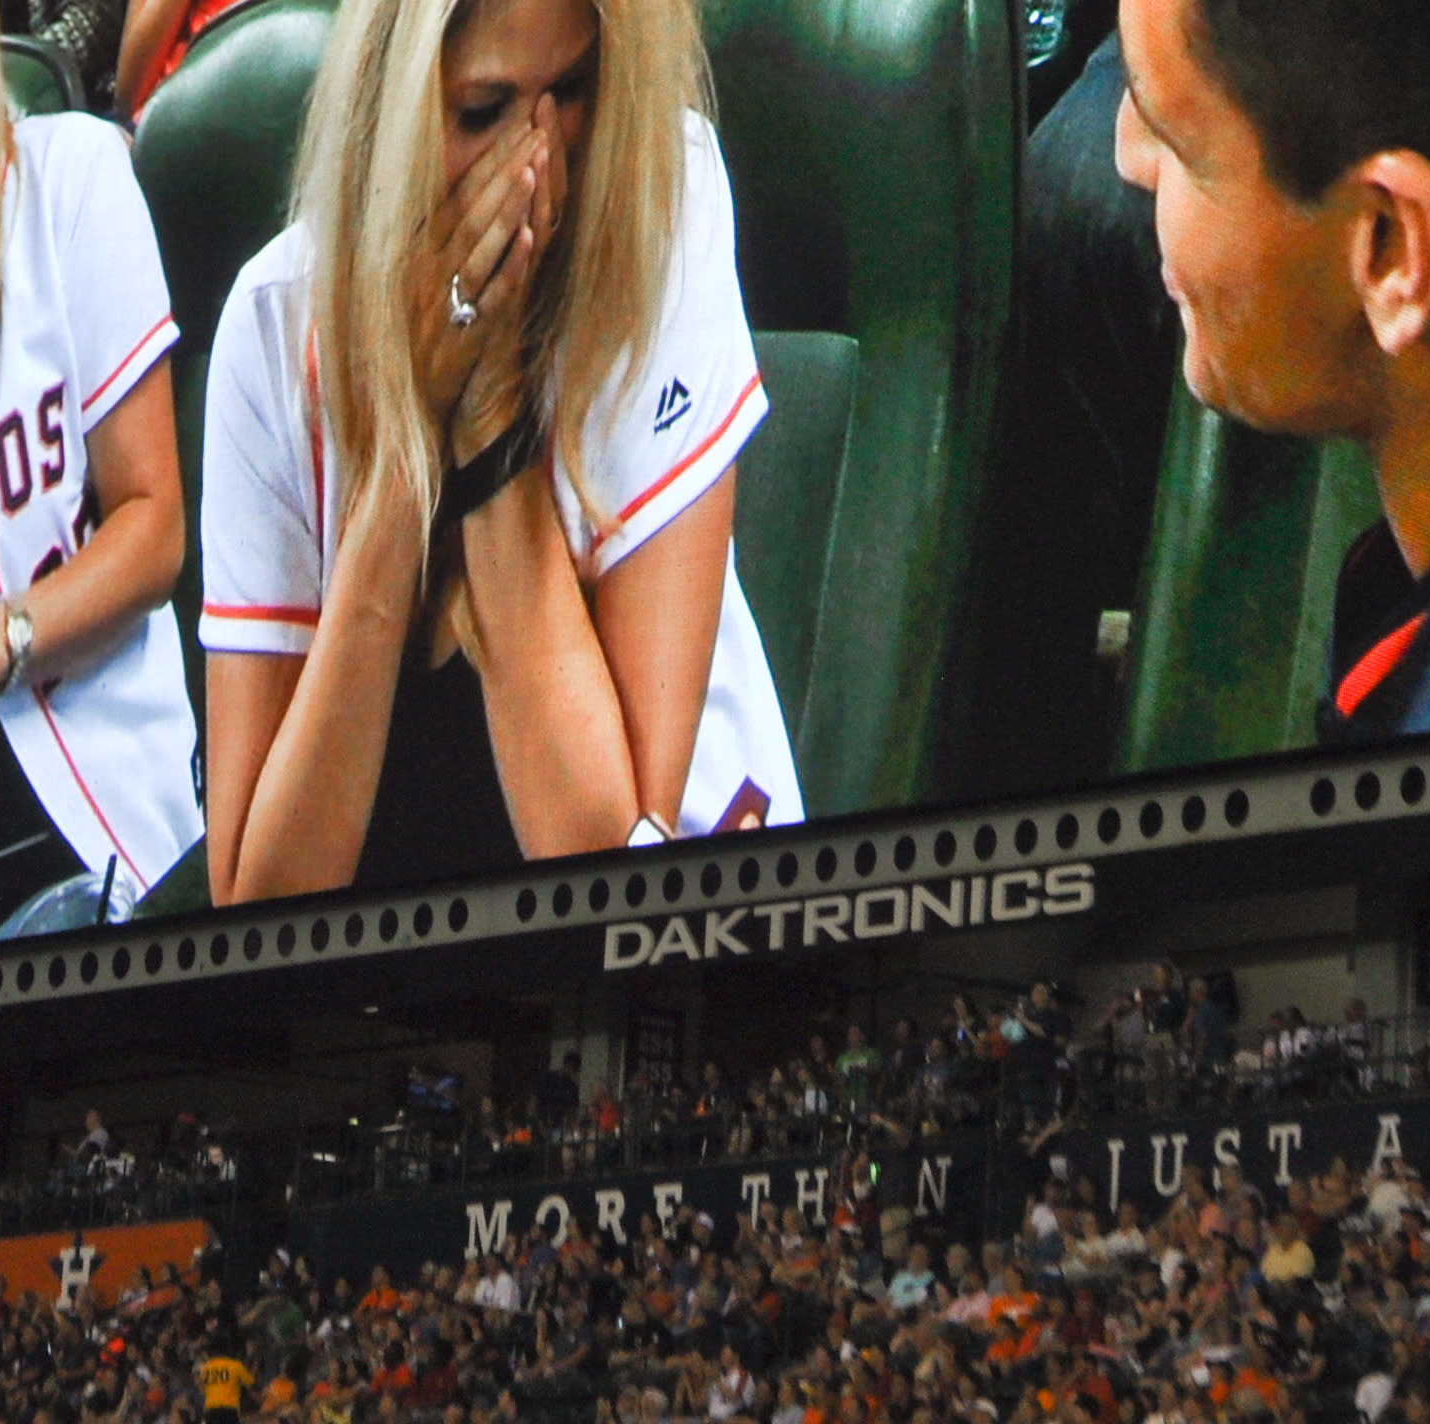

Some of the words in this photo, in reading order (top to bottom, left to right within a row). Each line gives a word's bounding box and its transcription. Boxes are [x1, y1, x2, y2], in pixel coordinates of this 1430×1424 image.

[602, 862, 1095, 971] DAKTRONICS
[464, 1182, 683, 1260] MORE
[740, 1156, 953, 1232] THN
[1106, 1122, 1304, 1214] JUST
